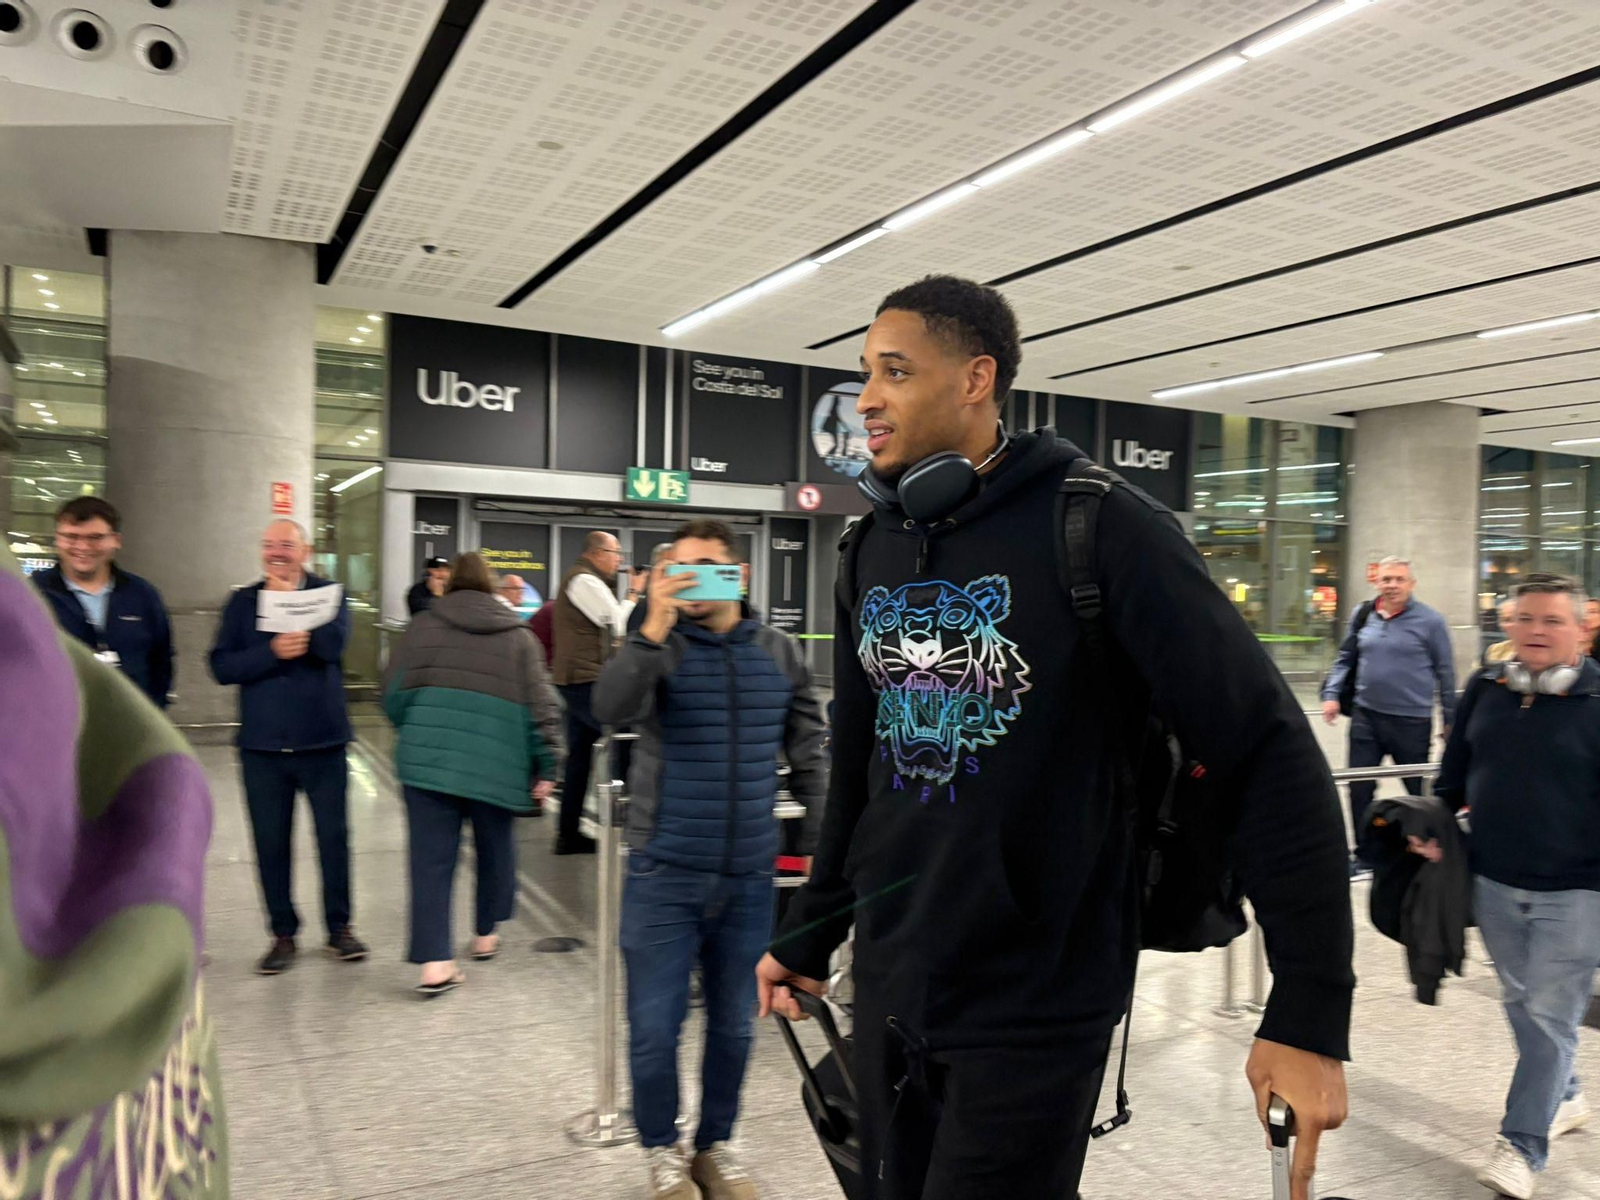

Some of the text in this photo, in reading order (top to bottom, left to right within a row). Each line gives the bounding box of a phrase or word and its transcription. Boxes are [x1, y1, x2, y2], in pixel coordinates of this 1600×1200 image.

[692, 359, 765, 381] See you in
[416, 367, 522, 412] Uber
[692, 377, 784, 399] Costa del Sol
[691, 456, 729, 473] Uber
[1112, 438, 1174, 470] Uber
[772, 537, 805, 551] Uber
